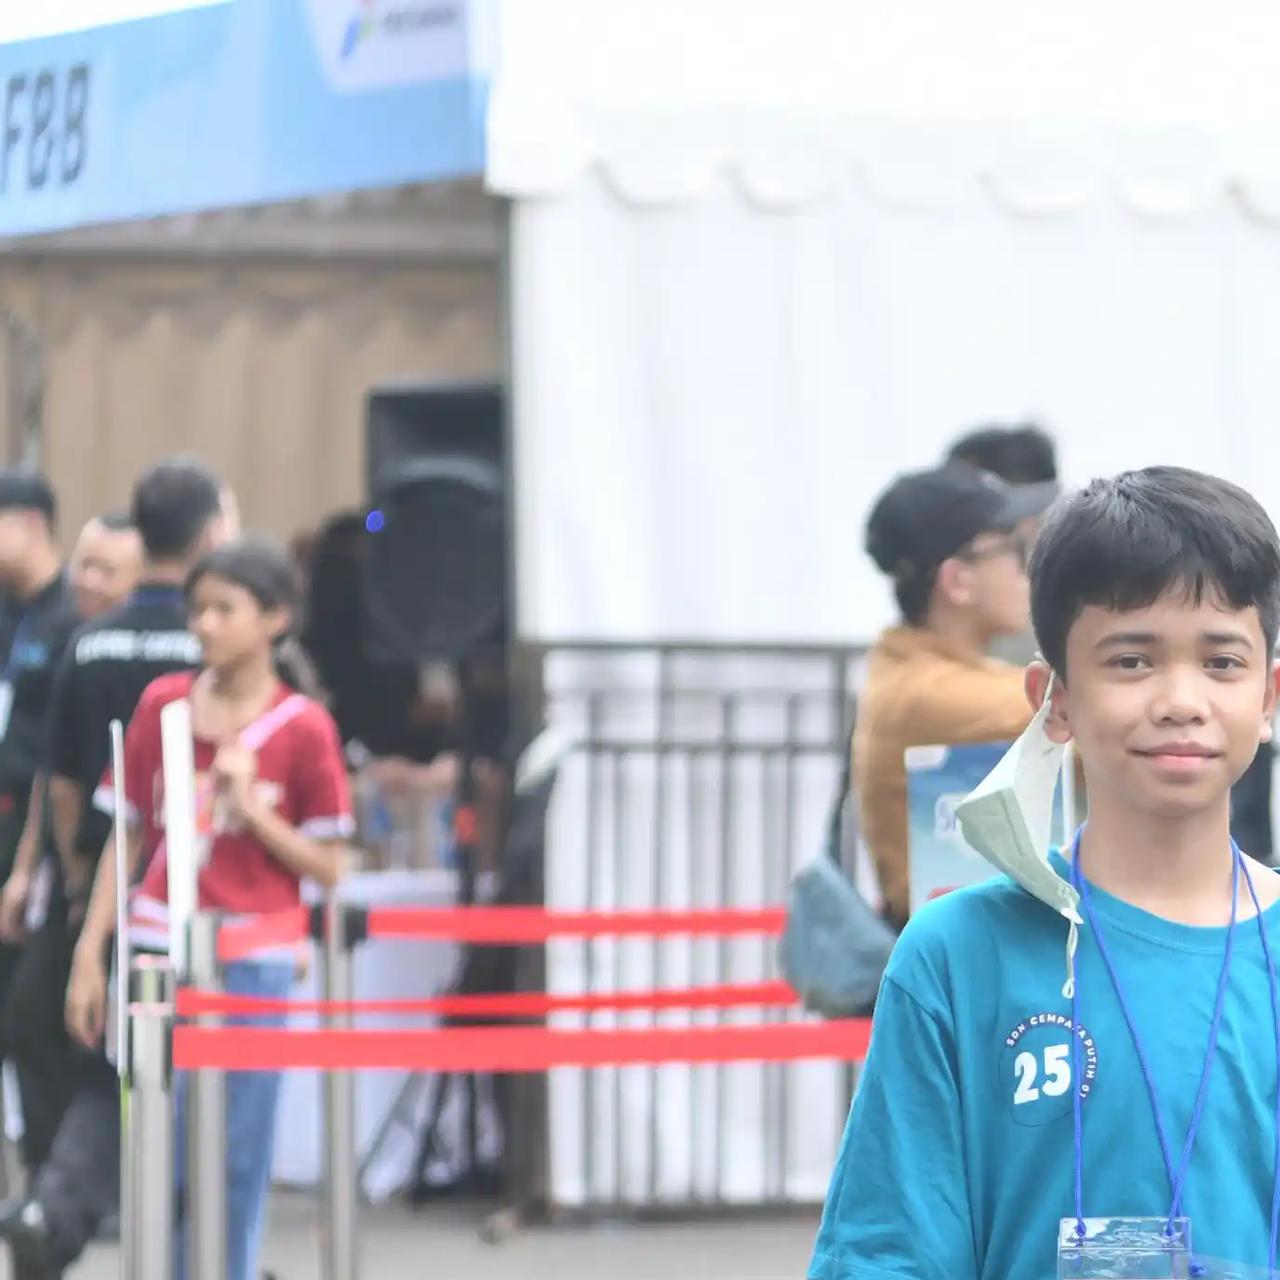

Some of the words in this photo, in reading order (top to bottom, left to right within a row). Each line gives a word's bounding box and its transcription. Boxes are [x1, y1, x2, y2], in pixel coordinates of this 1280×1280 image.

[1006, 1023, 1026, 1047] SDN
[1030, 1013, 1087, 1039] CEMPAA
[1084, 1038, 1097, 1079] PUTIH
[1013, 1044, 1072, 1105] 25
